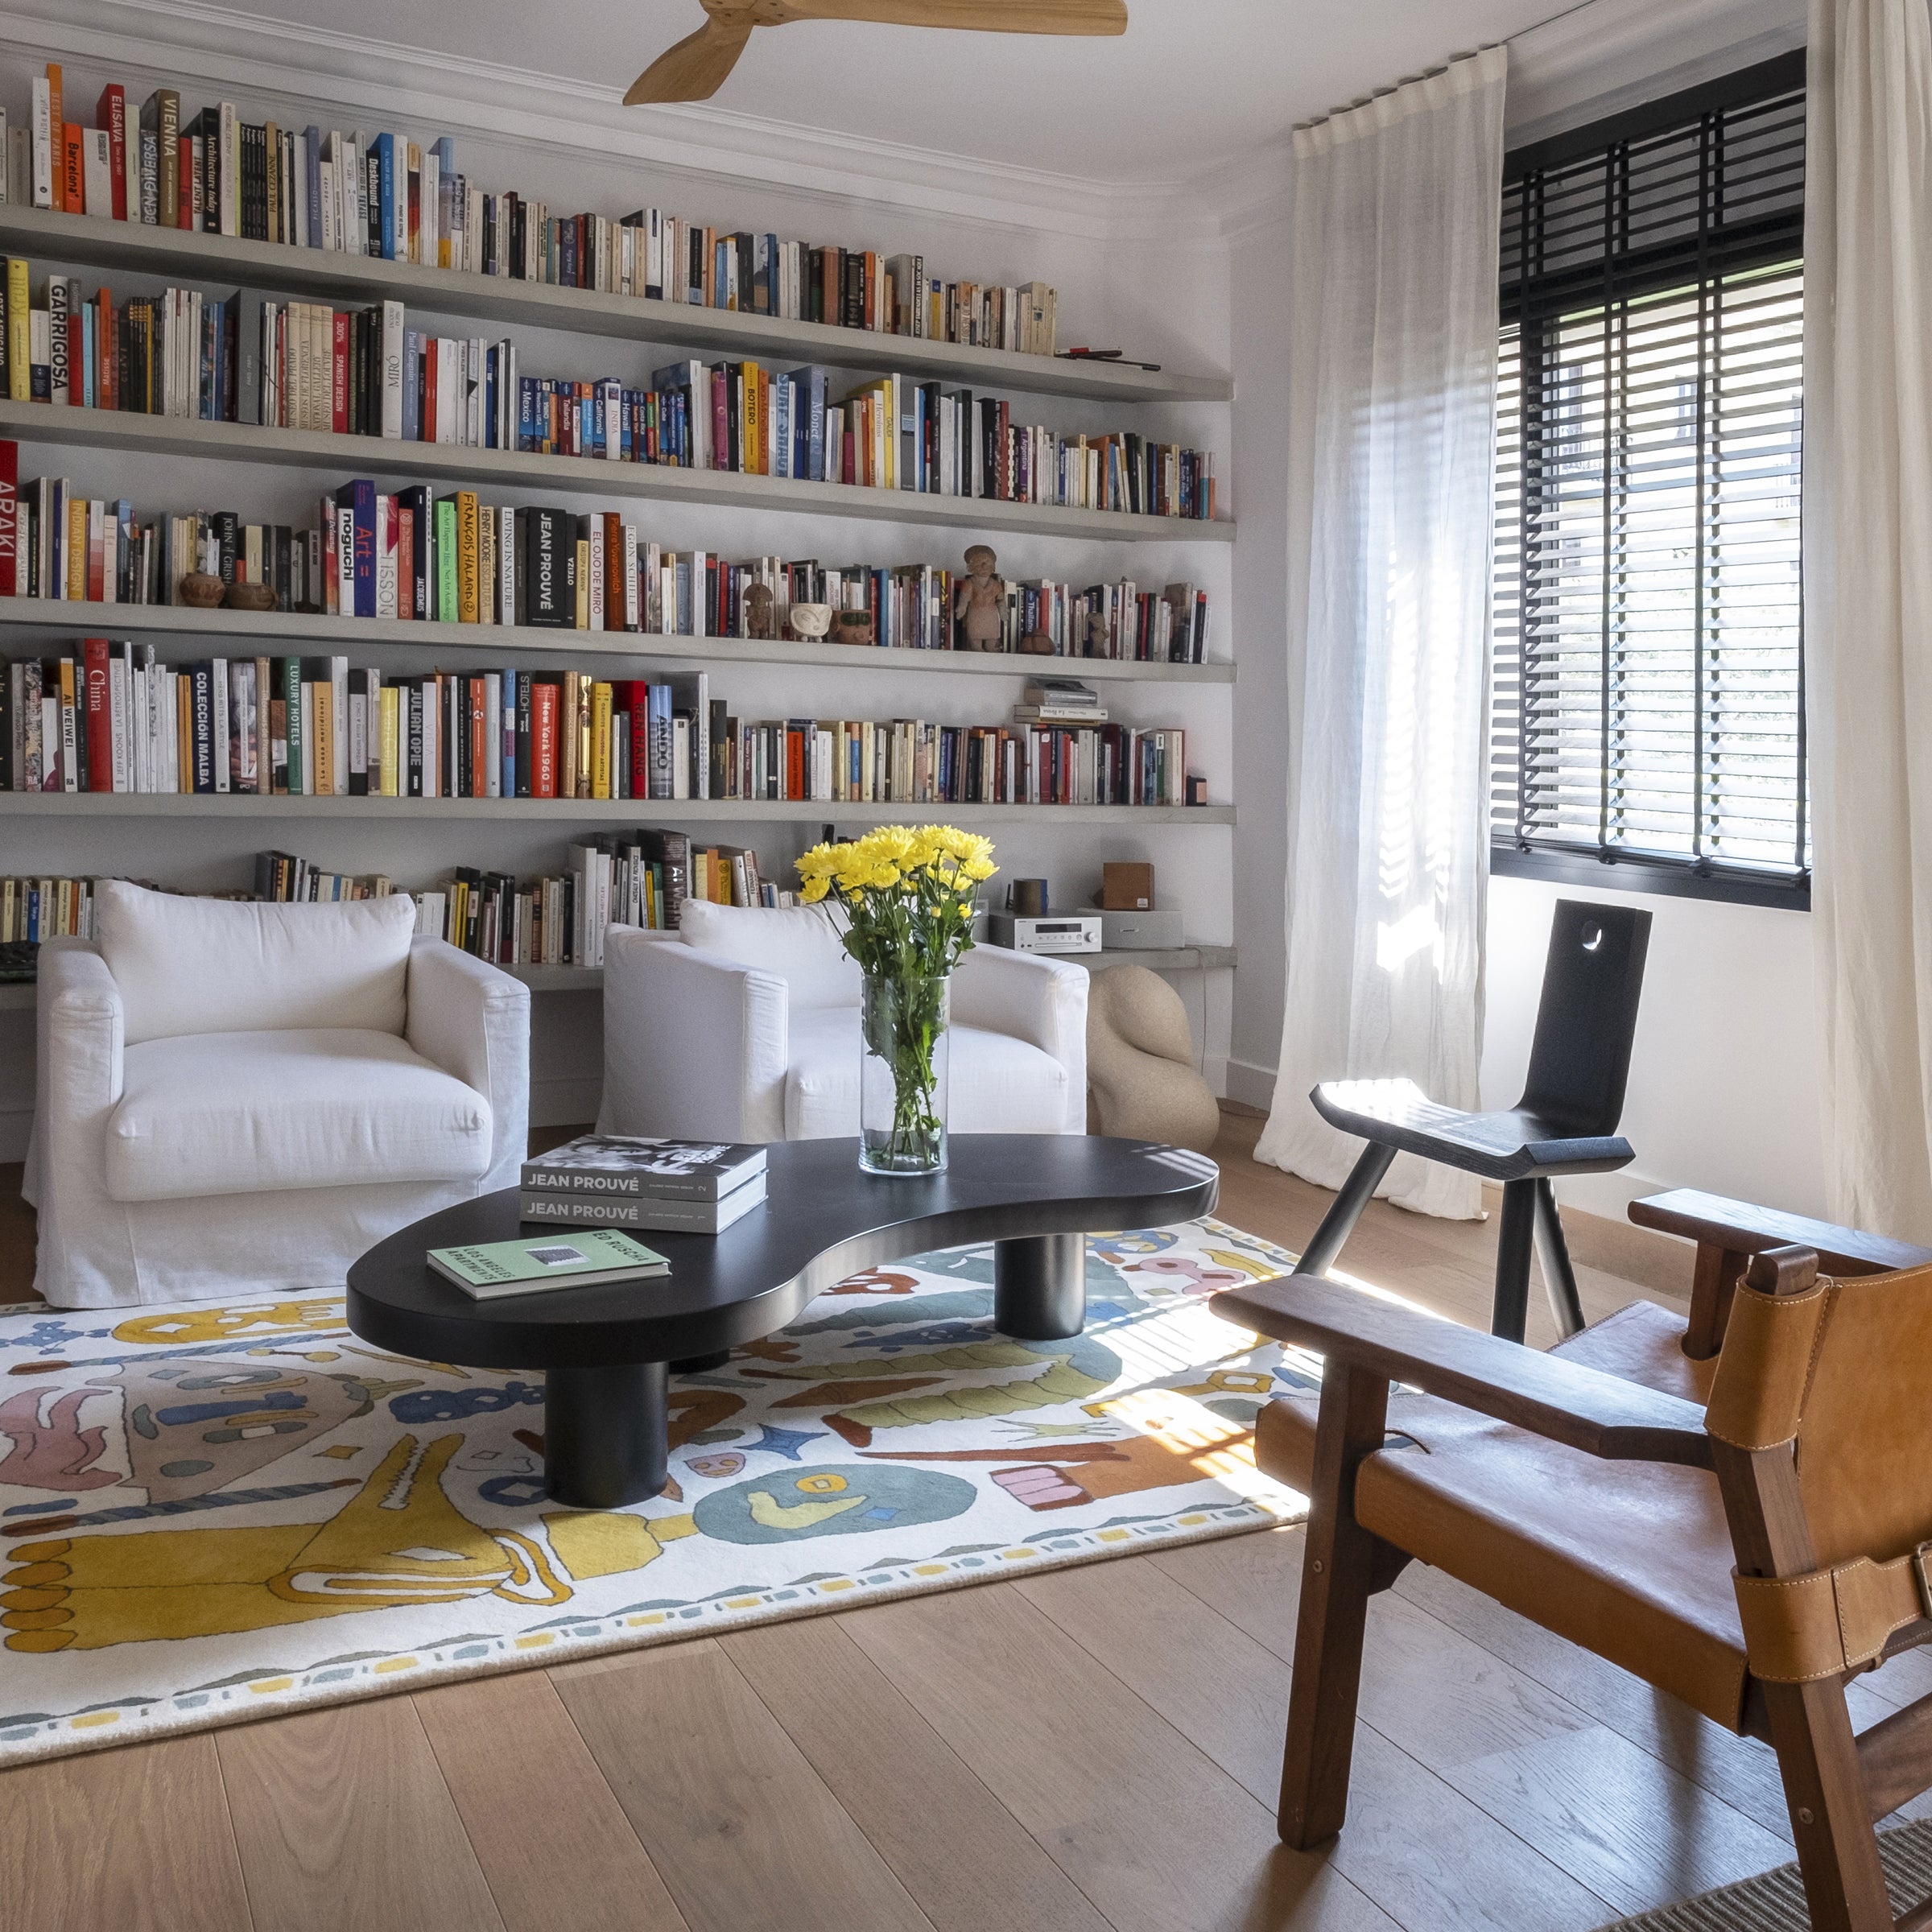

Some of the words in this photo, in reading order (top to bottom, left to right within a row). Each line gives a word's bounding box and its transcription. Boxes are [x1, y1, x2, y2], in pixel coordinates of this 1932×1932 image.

[111, 95, 122, 142] ELISAVA
[164, 99, 177, 157] VIENNA
[194, 156, 202, 184] LATENT
[208, 134, 217, 190] Architecture
[369, 158, 380, 208] Deskbound
[194, 186, 202, 214] TALENT
[206, 192, 215, 214] today
[52, 285, 68, 390] GARRIGOSA
[336, 320, 345, 343] 300%
[409, 332, 417, 348] Paul
[335, 354, 344, 385] SPANISH
[407, 349, 416, 382] Gauguin
[335, 387, 343, 412] DESIGN
[522, 391, 531, 423] Mexico
[747, 388, 755, 425] BOTERO
[622, 402, 630, 431] Hawaii
[811, 402, 823, 440] Monet
[0, 481, 15, 557] ARAKI
[72, 502, 84, 544] INDIAN
[327, 499, 336, 520] Sonia
[464, 494, 474, 551] FRANÇOIS
[481, 509, 491, 535] HENRY
[223, 518, 233, 544] JOHN
[326, 520, 336, 554] Delaunay
[356, 526, 374, 559] Art
[504, 510, 513, 547] LIVING
[541, 513, 552, 550] JEAN
[592, 531, 602, 543] EL
[611, 517, 619, 543] Pierre
[341, 513, 354, 580] noguchi
[482, 535, 491, 562] MOORE
[504, 550, 512, 562] IN
[592, 548, 602, 568] OJO
[71, 549, 81, 591] DESIGN
[222, 555, 233, 584] GRISH
[464, 554, 473, 601] HALARD
[540, 554, 554, 610] PROUVÉ
[592, 572, 602, 584] DE
[610, 543, 621, 594] Yovanovitch
[628, 560, 636, 605] SCHIELE
[417, 576, 425, 612] JACQUEMUS
[482, 563, 491, 609] ESCULTURA
[504, 565, 513, 608] NATURE
[592, 587, 604, 615] MIRÓ
[63, 694, 72, 704] AI
[90, 670, 106, 712] China
[290, 665, 299, 705] LUXURY
[520, 676, 530, 712] HOTELS
[196, 671, 208, 741] COLECCIÓN
[411, 689, 422, 734] JULIAN
[543, 702, 551, 724] New
[634, 702, 644, 734] REN
[64, 708, 74, 747] WEIWEI
[291, 708, 299, 746] HOTELS
[542, 726, 551, 751] York
[657, 715, 668, 770] ANDO
[198, 743, 209, 786] MALBA
[410, 737, 422, 766] OPIE
[541, 753, 551, 781] 1960
[634, 740, 644, 777] HANG
[320, 770, 325, 779] La
[528, 1173, 570, 1188] JEAN
[573, 1176, 639, 1191] PROUVÉ
[527, 1202, 569, 1216] JEAN
[573, 1204, 638, 1220] PROUVÉ
[464, 1248, 481, 1258] LOS
[478, 1257, 516, 1278] ANGELES
[592, 1232, 607, 1241] ED
[605, 1241, 650, 1262] RUSCHA
[445, 1249, 497, 1281] APARTMENTS
